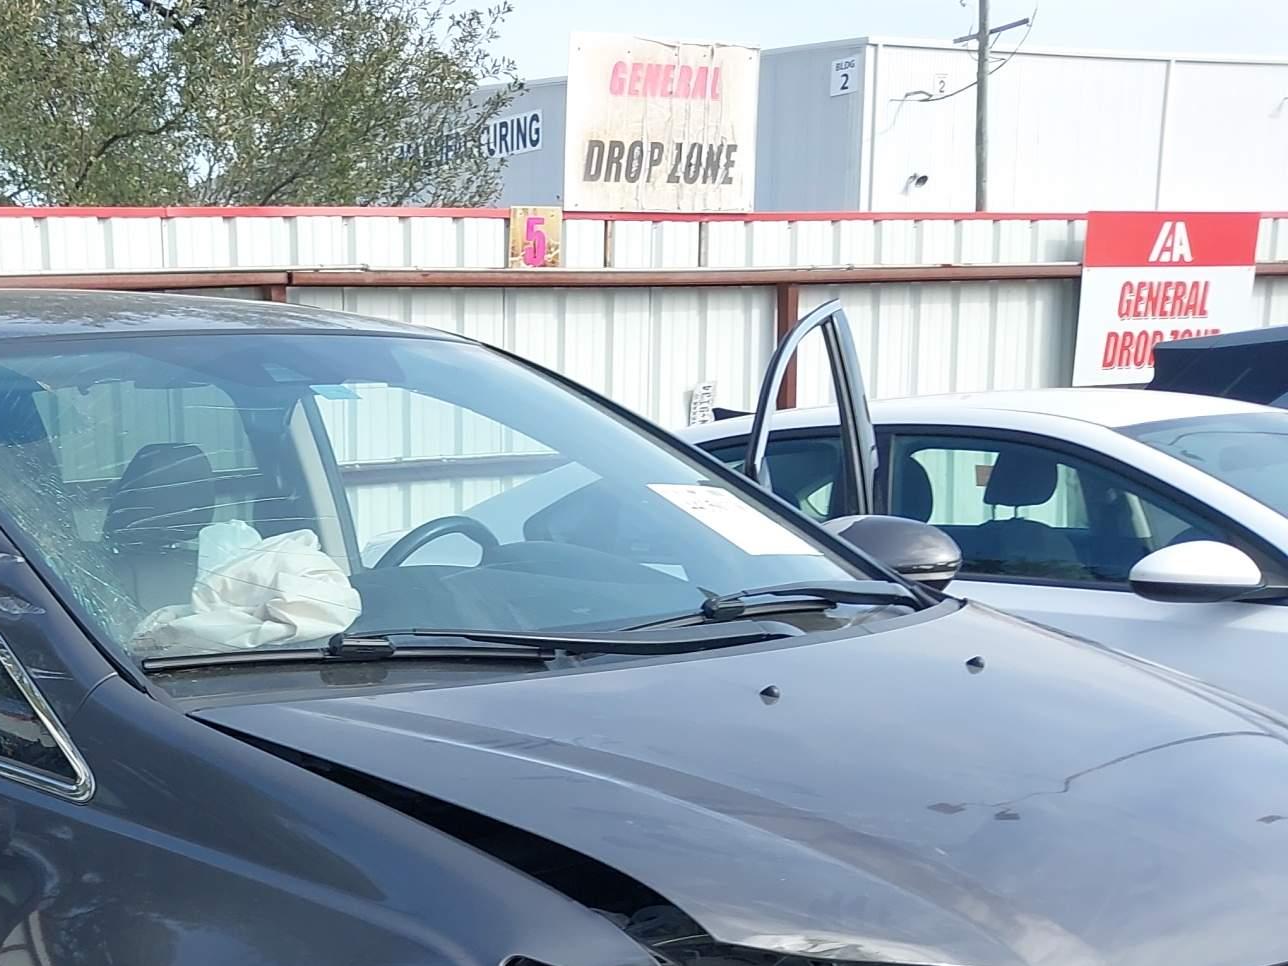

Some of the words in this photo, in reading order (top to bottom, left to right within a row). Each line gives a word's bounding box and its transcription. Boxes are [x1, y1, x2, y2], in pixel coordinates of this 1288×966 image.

[609, 60, 720, 100] GENERAL
[835, 60, 856, 71] BLDG
[840, 73, 849, 90] 2
[582, 139, 665, 184] DROP
[666, 142, 738, 185] ZONE
[523, 217, 546, 266] 5
[1117, 280, 1210, 320] GENERAL
